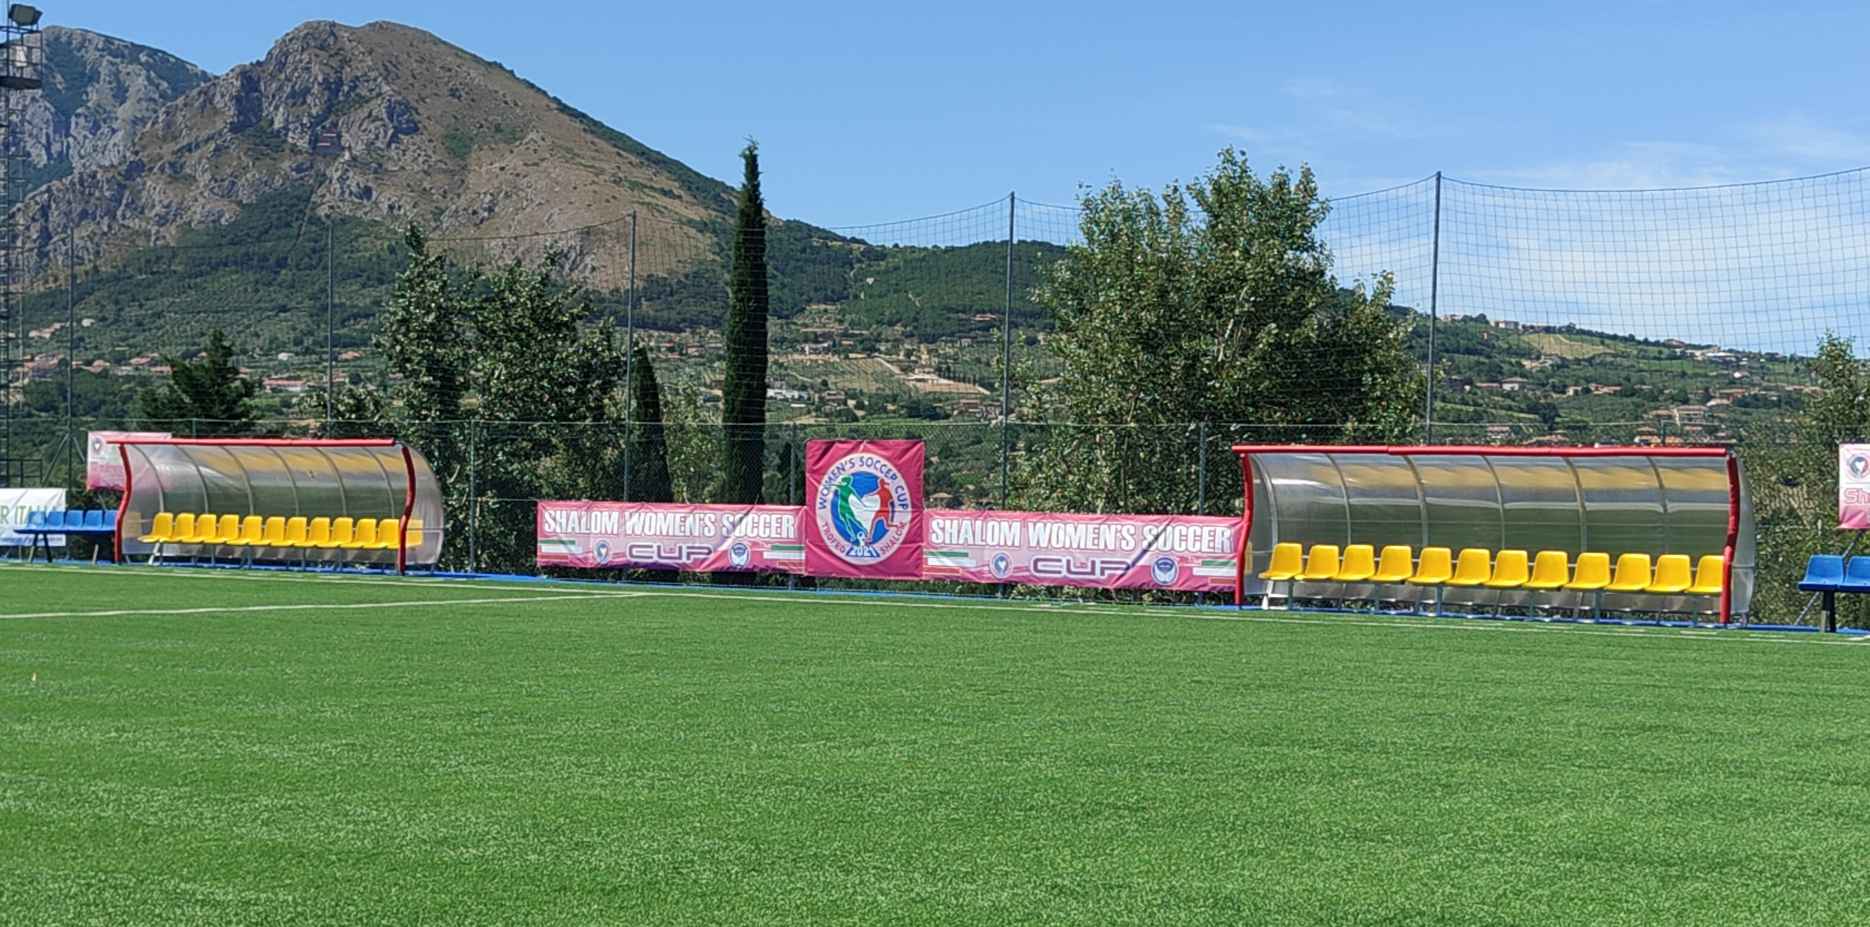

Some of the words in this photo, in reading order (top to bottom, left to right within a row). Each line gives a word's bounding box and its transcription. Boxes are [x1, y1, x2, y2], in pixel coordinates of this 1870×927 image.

[818, 457, 856, 510] WOMEN'S
[858, 456, 898, 482] SOCCER
[895, 484, 909, 510] CUP
[543, 510, 619, 535] SHALOM
[624, 511, 717, 537] WOMEN'S
[722, 512, 796, 538] SOCCER
[931, 519, 1021, 546] SHALOM
[1027, 520, 1135, 550] WOMEN'S
[1142, 523, 1233, 552] SOCCER
[628, 544, 713, 561] CUP
[848, 546, 878, 557] 2021
[1033, 558, 1131, 577] CUP
